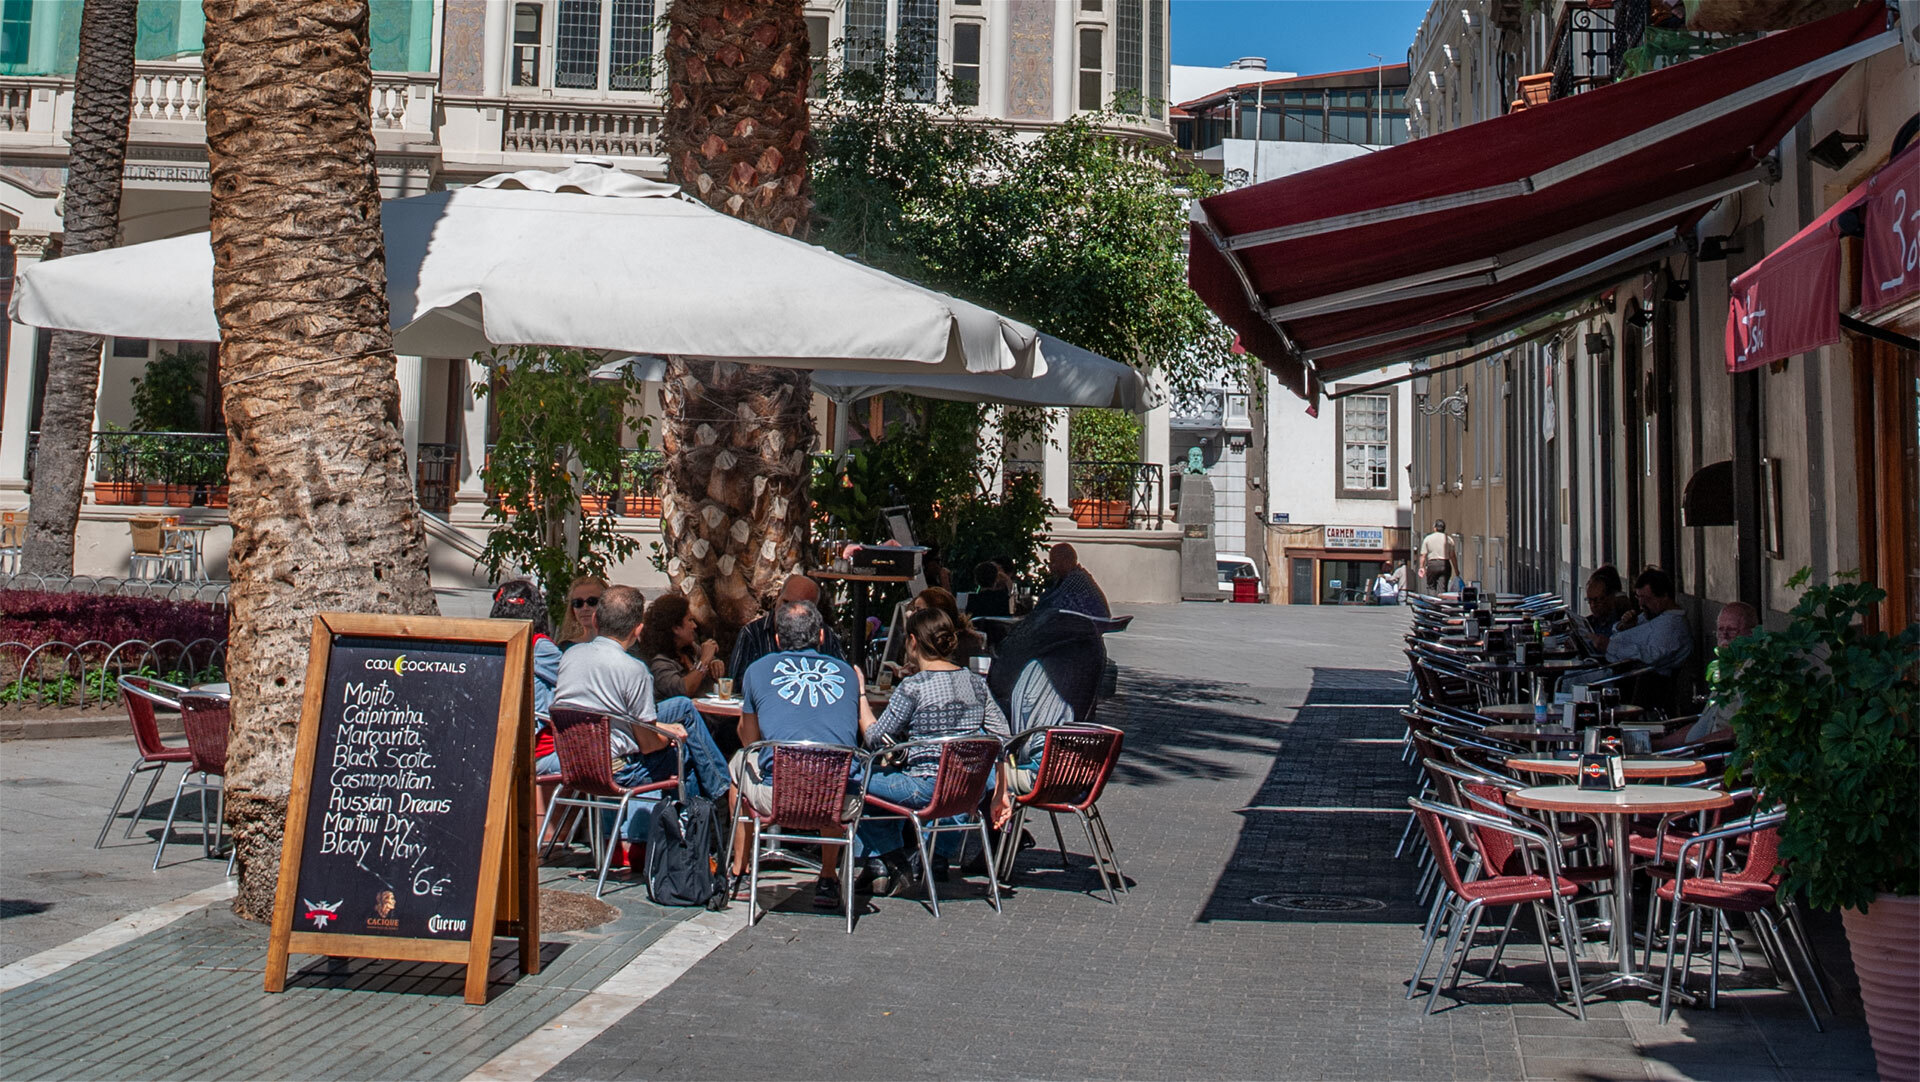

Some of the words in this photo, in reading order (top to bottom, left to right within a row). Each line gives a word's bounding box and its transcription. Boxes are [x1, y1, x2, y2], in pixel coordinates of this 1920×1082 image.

[1327, 528, 1354, 538] CARMEN
[365, 659, 394, 670] COOL
[400, 660, 467, 673] COCKTAILS
[332, 744, 379, 768] Black
[329, 787, 392, 812] Russian
[323, 811, 380, 833] Martini
[320, 831, 371, 866] Blody
[380, 834, 427, 868] Mary
[413, 866, 451, 896] 6€
[367, 918, 400, 926] CACIQUE
[428, 914, 467, 933] Cuervo
